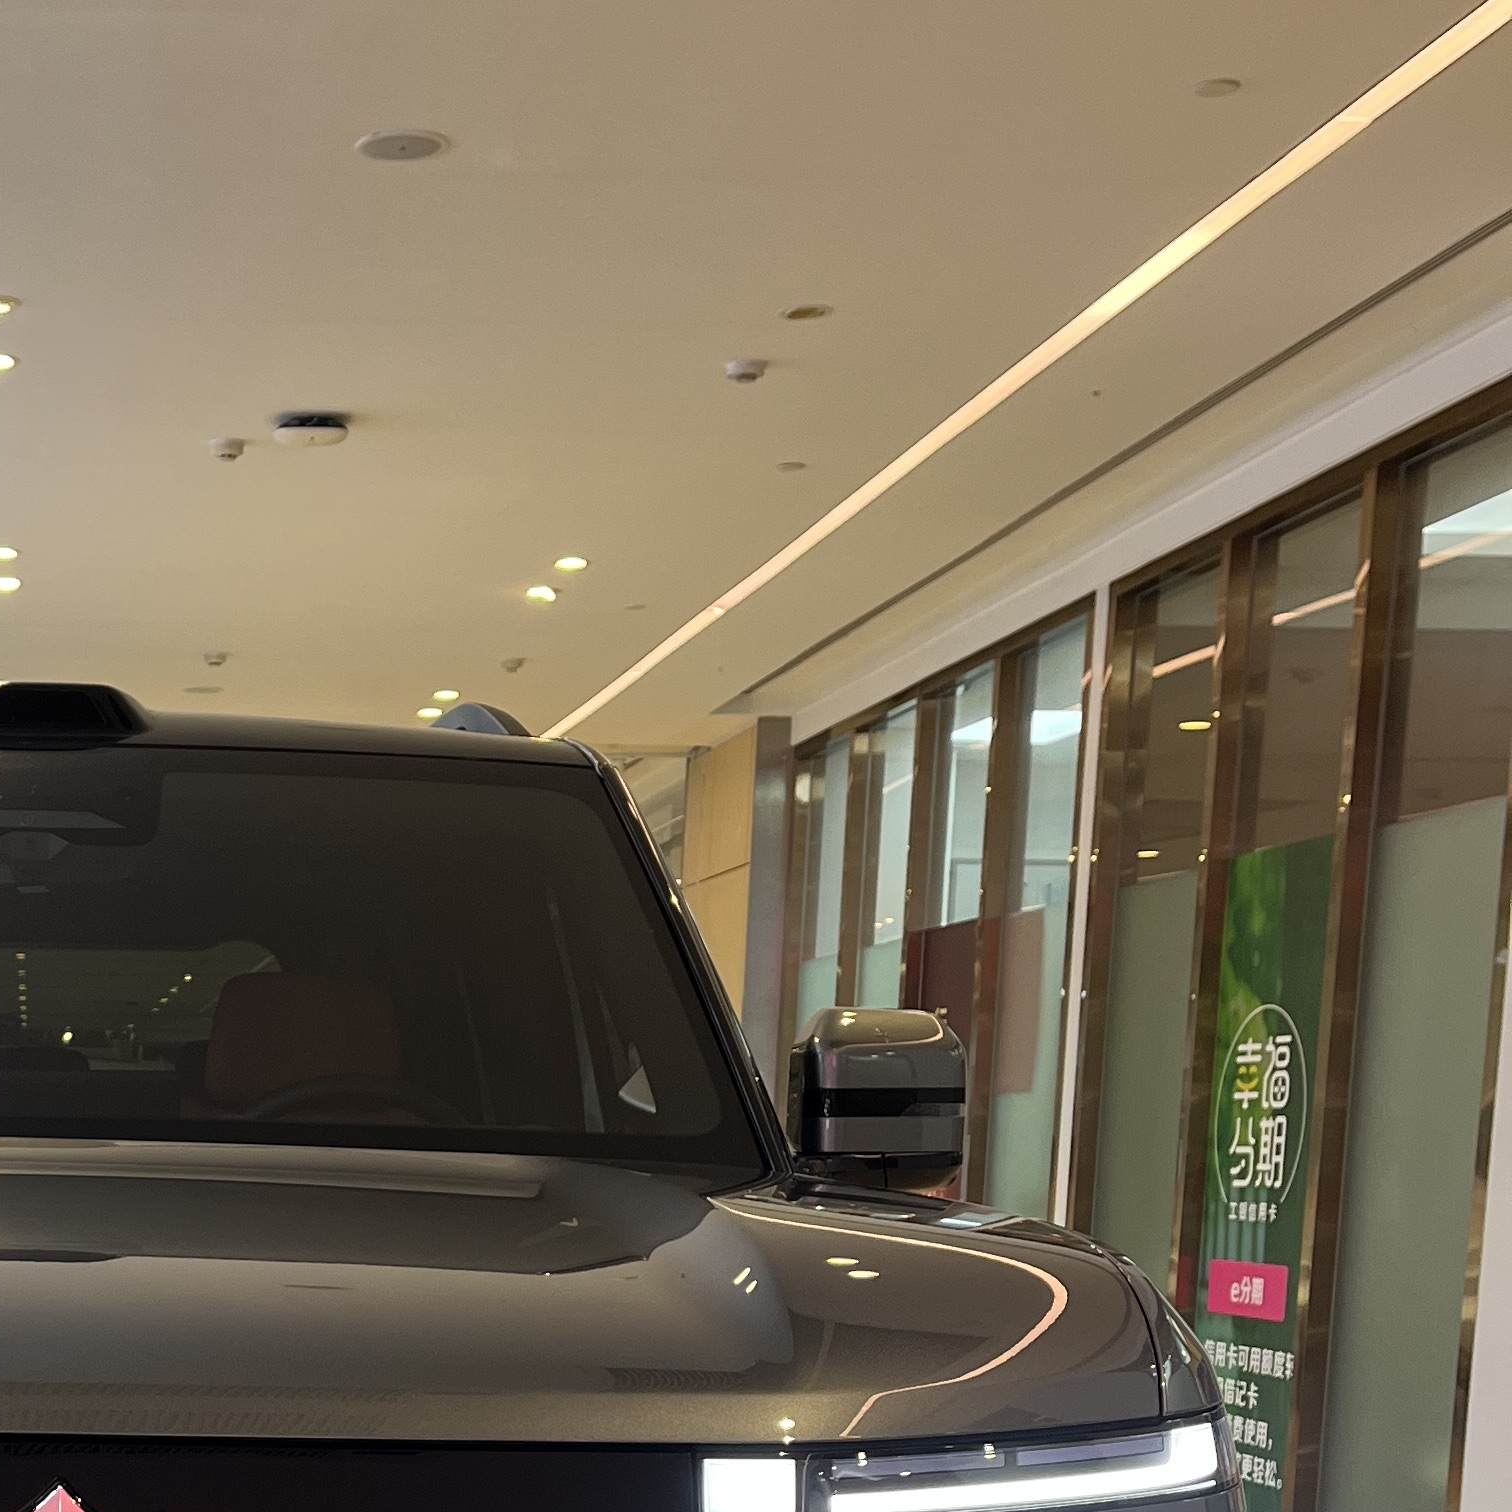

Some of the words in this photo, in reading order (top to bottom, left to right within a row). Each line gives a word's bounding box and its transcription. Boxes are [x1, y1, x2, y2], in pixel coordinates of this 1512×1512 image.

[1233, 1034, 1293, 1109] 幸福
[1228, 1115, 1287, 1189] 分期
[1230, 1275, 1265, 1306] e分期
